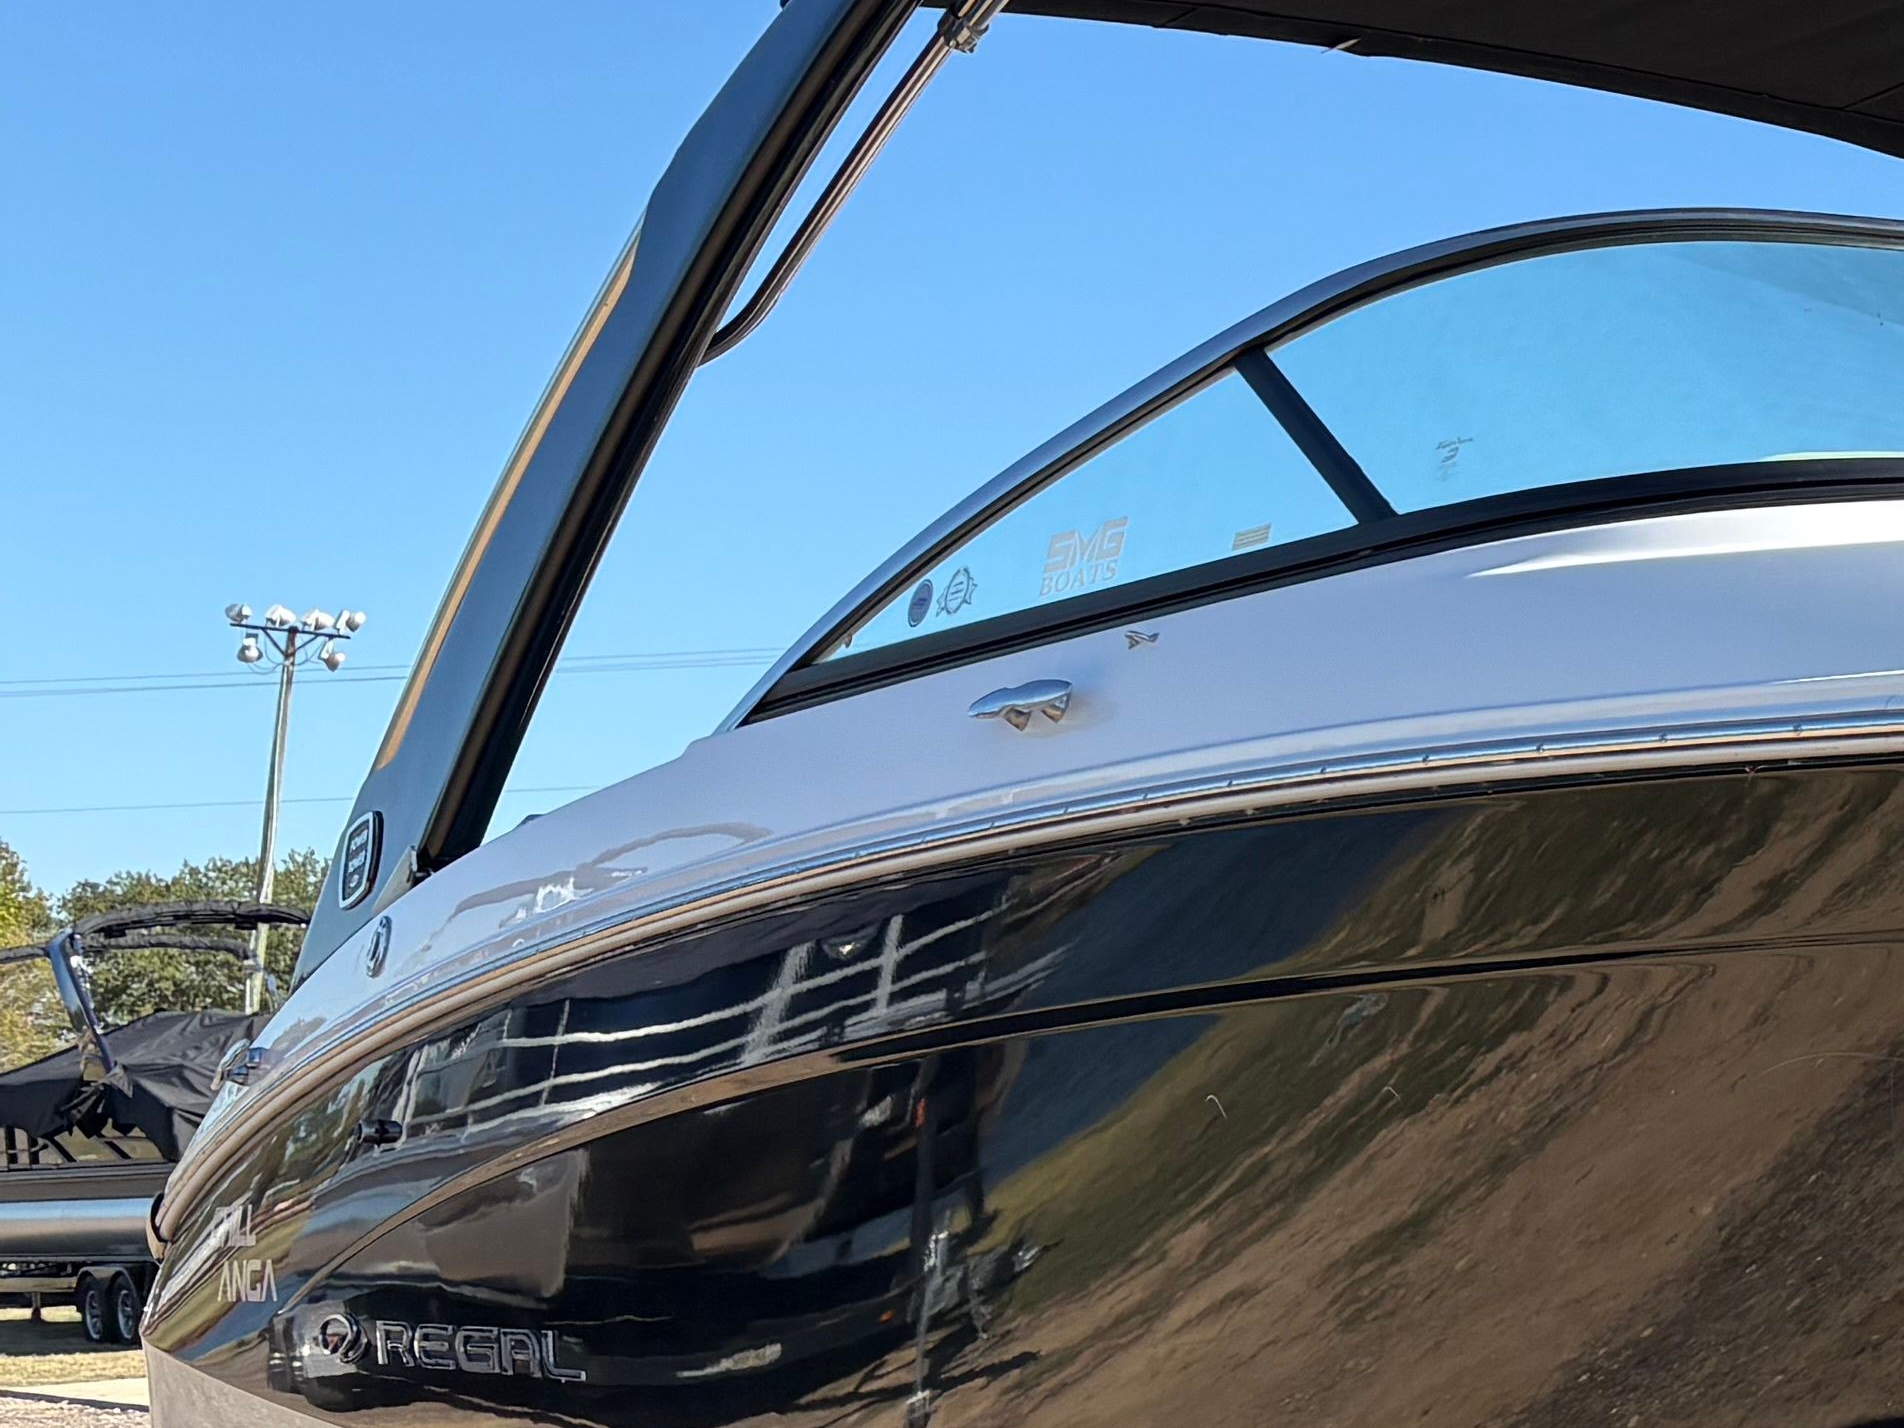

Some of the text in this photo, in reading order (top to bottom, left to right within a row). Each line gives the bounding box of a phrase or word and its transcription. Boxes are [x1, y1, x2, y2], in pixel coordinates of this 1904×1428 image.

[1044, 516, 1128, 572] SMG
[1040, 563, 1116, 596] BOATS
[376, 1320, 586, 1382] REGAL
